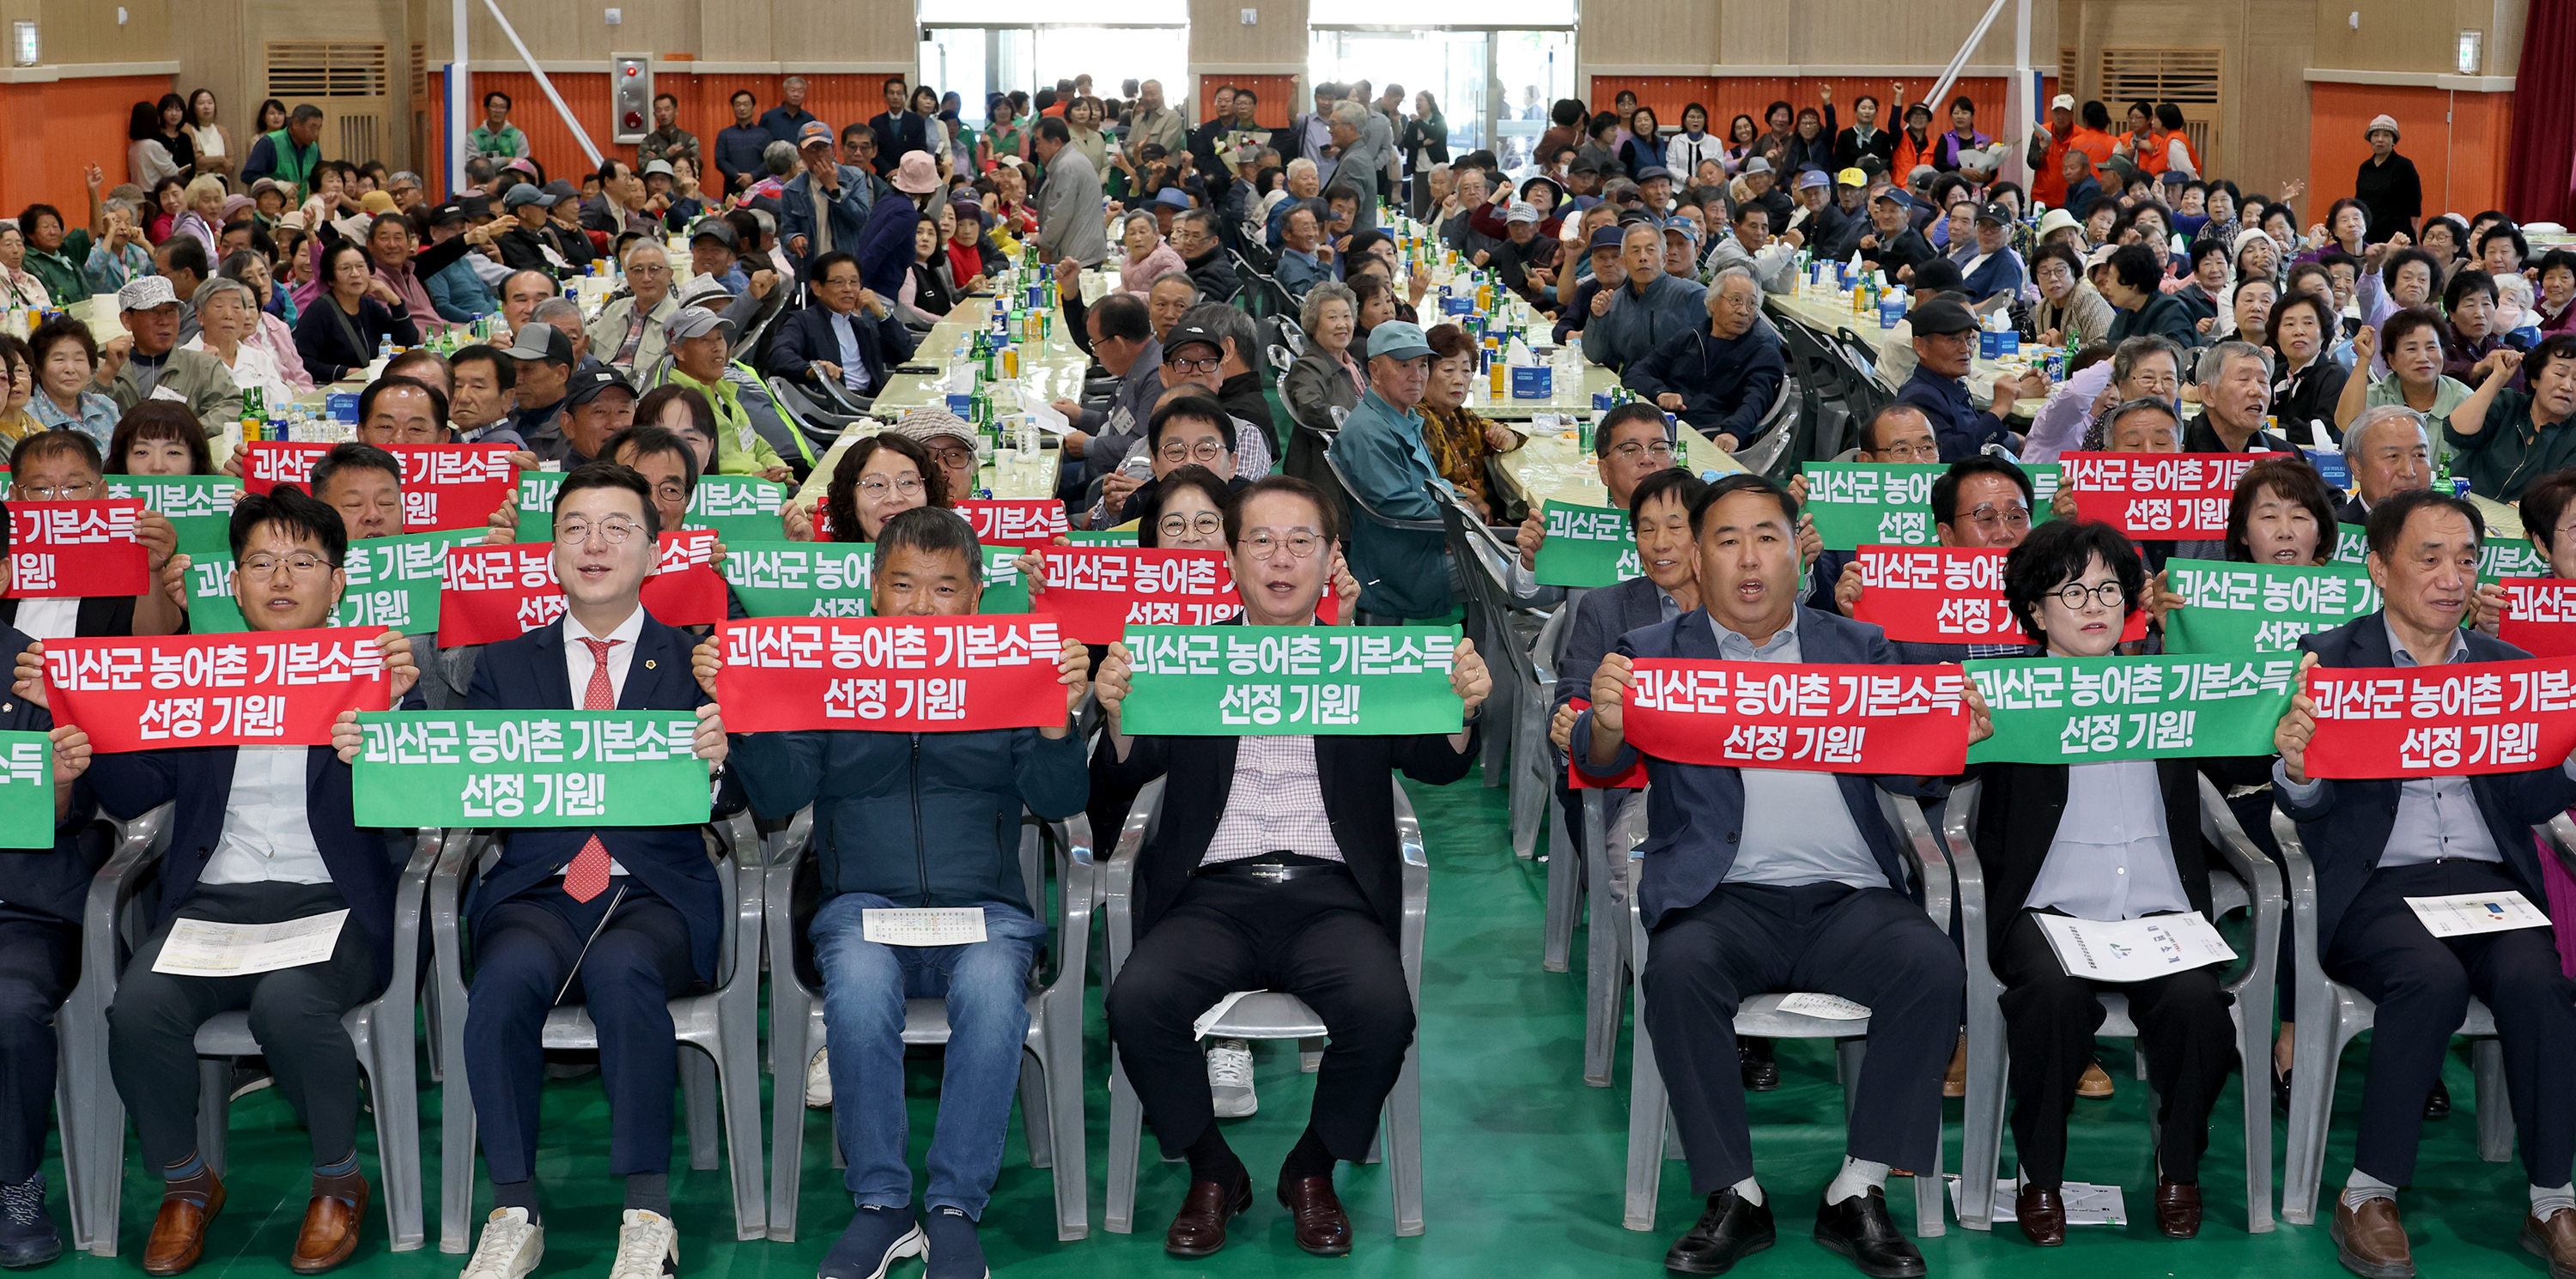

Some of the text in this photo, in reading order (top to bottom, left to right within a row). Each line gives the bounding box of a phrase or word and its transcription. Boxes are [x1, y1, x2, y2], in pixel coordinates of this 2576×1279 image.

[412, 451, 513, 484] 기본소득
[1807, 470, 1880, 504] 괴산군
[2059, 458, 2127, 492] 괴산군
[2130, 458, 2203, 492] 농어촌
[2208, 459, 2248, 490] 기본
[137, 483, 237, 518] 기본소득
[684, 482, 783, 517] 기본소득
[2124, 497, 2230, 531] 선정 기원!
[22, 507, 138, 545] 기본소득
[976, 506, 1069, 539] 기본소득
[1546, 509, 1621, 542] 괴산군
[1877, 512, 1926, 545] 선정
[725, 550, 872, 591] 괴산군 농어
[1046, 554, 1128, 592] 괴산군
[1133, 556, 1216, 595] 농어촌
[1615, 551, 1642, 583] 선
[1860, 553, 1939, 590] 괴산군
[2477, 546, 2552, 579] 기본소
[345, 589, 411, 627] 기원!
[2176, 569, 2258, 611] 괴산군
[2263, 573, 2347, 615] 농어촌
[1936, 598, 1990, 634] 선정
[45, 637, 386, 691] 괴산군 농어촌 기본소득
[726, 622, 1064, 670] 괴산군 농어촌 기본소득
[1123, 633, 1456, 676] 괴산군 농어촌 기본소득
[823, 678, 967, 720] 선정 기원!
[1218, 683, 1361, 725] 선정 기원!
[1631, 669, 1965, 717] 괴산군 농어촌 기본소득
[1969, 660, 2293, 710] 괴산군 농어촌 기본소득
[2312, 669, 2576, 720] 괴산군 농어촌 기본
[138, 694, 286, 740] 선정 기원!
[2060, 710, 2196, 755] 선정 기원!
[361, 718, 701, 765] 괴산군 농어촌 기본소득
[1722, 724, 1866, 763] 선정 기원!
[2400, 722, 2539, 768] 선정 기원!
[460, 772, 606, 818] 선정 기원!
